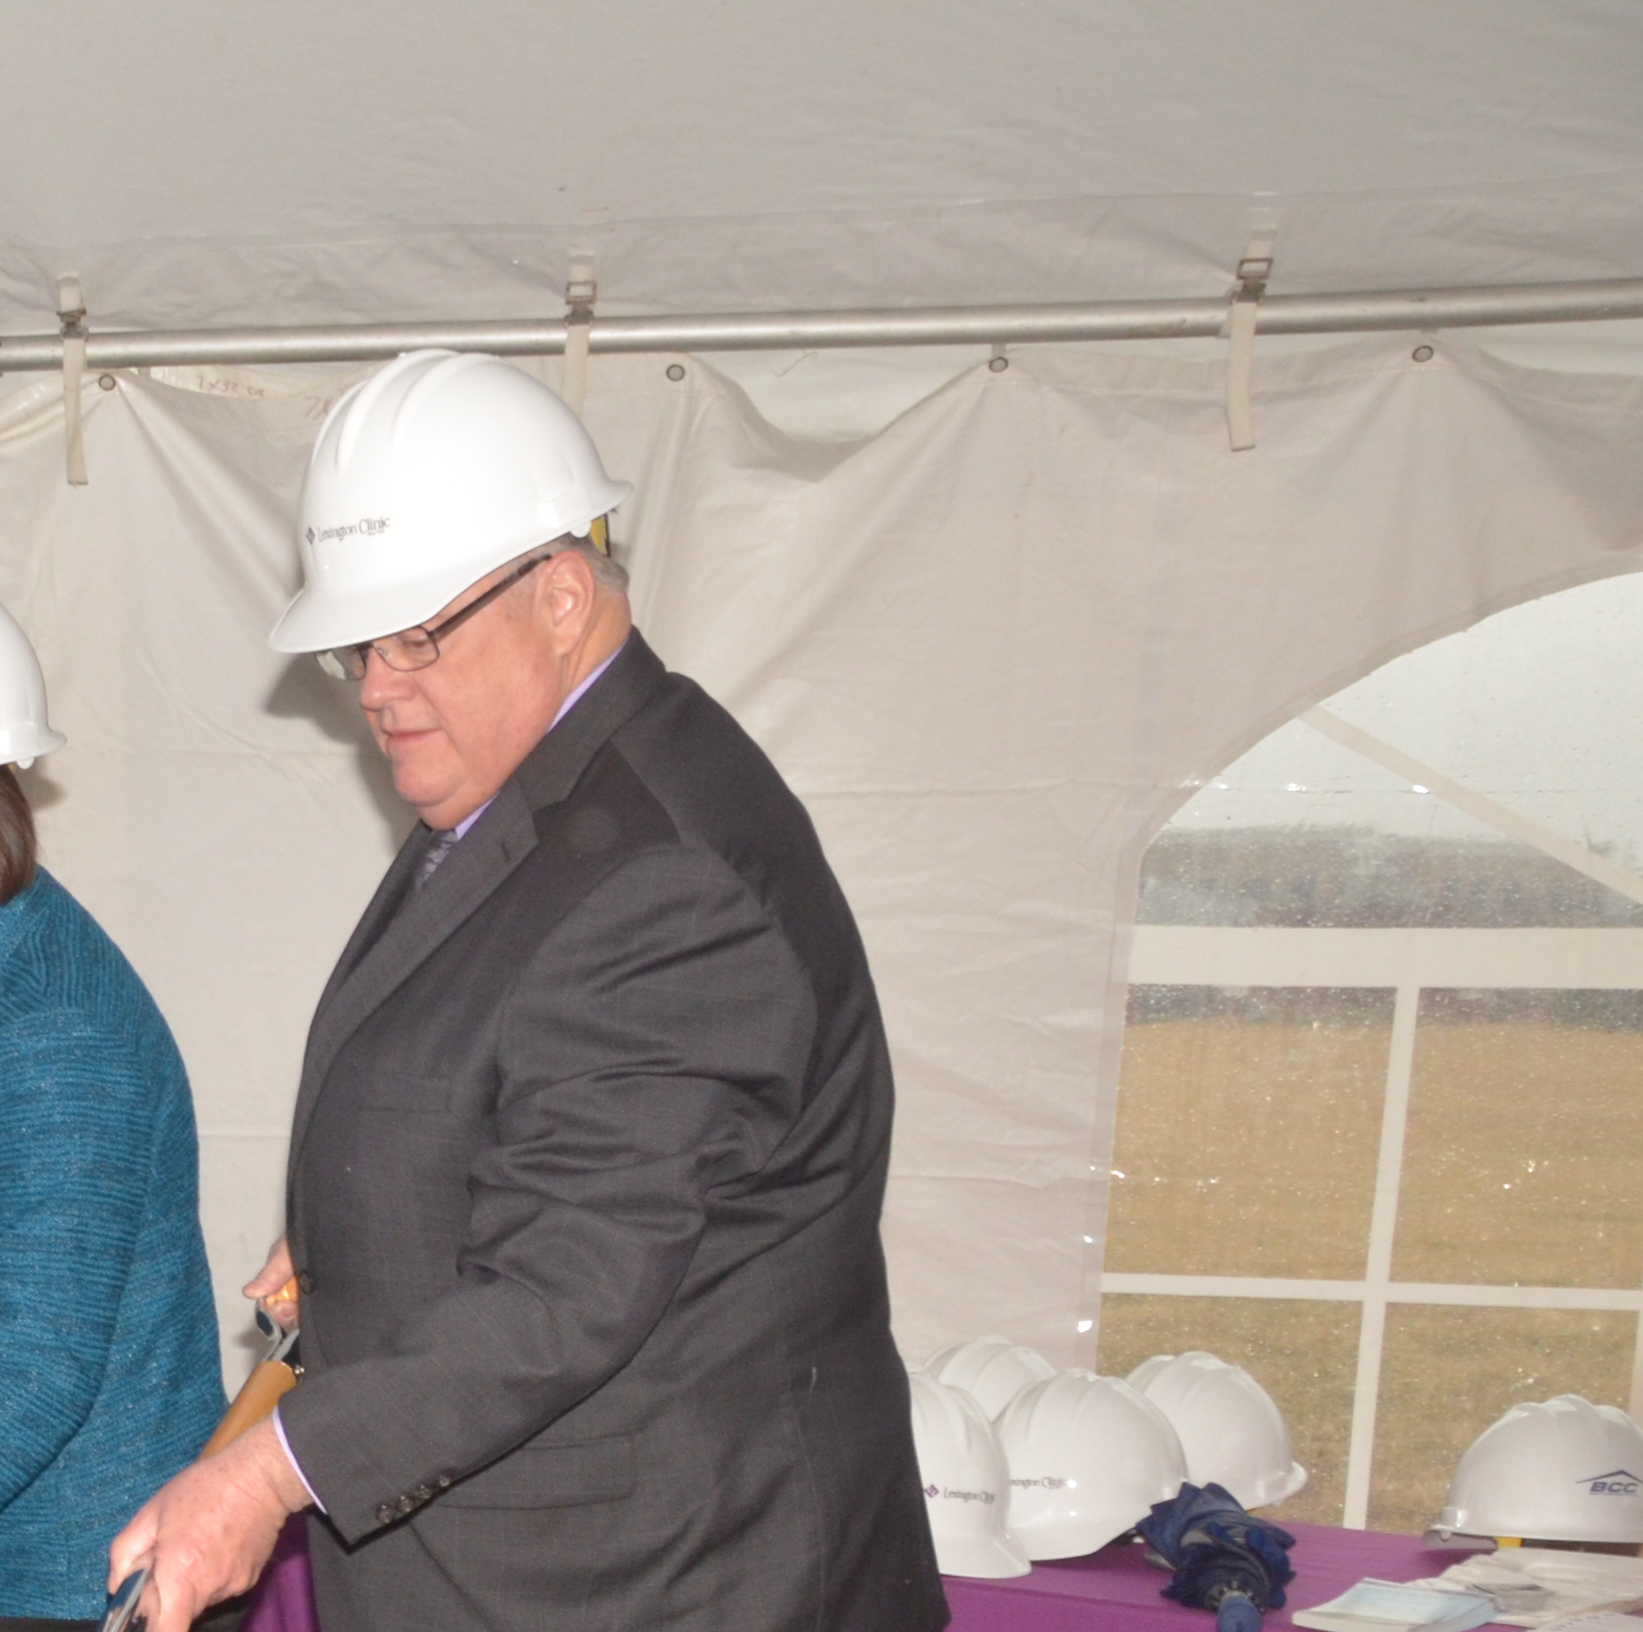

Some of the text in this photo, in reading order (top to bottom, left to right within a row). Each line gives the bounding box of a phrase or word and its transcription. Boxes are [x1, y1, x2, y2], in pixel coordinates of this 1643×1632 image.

[317, 516, 391, 542] Lexington Clinic
[1590, 1481, 1638, 1493] BCC
